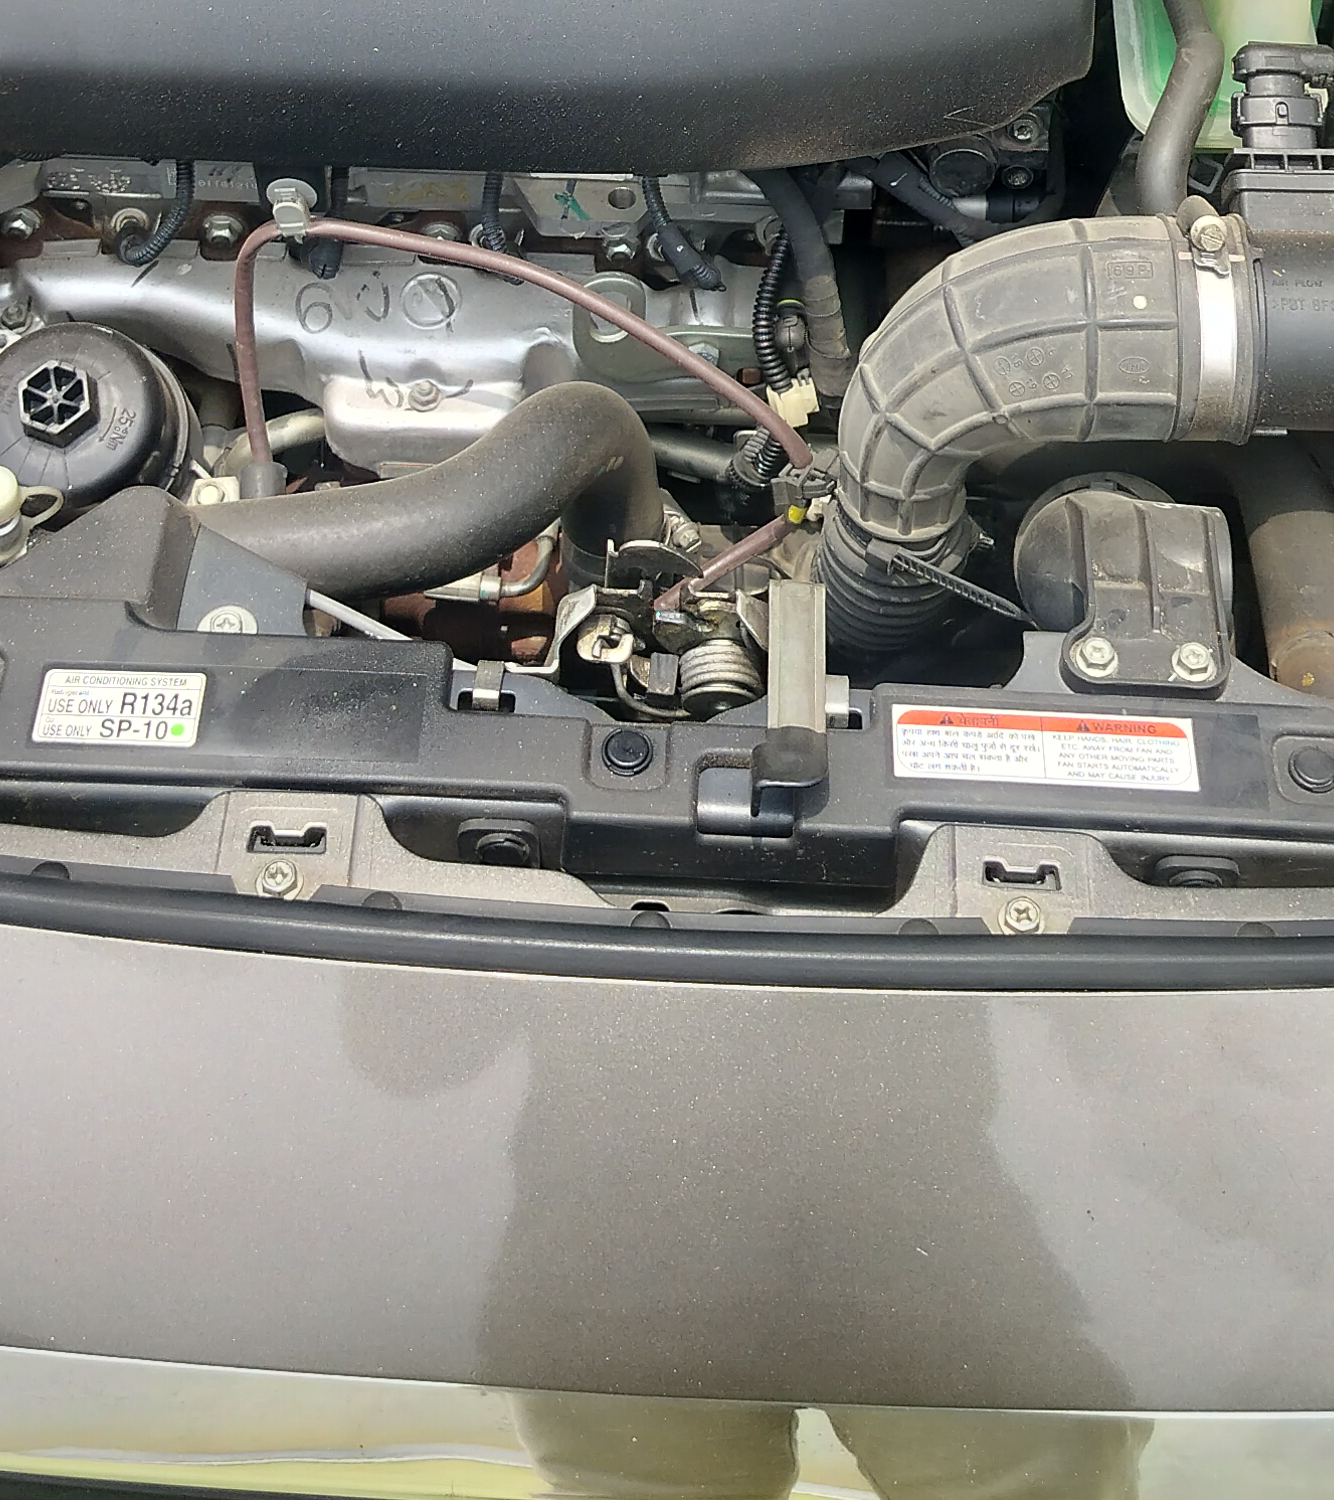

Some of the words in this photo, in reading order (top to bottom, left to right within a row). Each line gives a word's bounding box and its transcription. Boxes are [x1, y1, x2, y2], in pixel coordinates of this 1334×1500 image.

[64, 675, 81, 685] AIR
[82, 675, 149, 687] CONDITIONING
[150, 677, 188, 688] SYSTEM
[47, 698, 74, 714] USE
[78, 698, 114, 715] ONLY
[119, 691, 194, 717] R134a
[42, 723, 64, 737] USE
[65, 724, 93, 738] ONLY
[99, 717, 169, 740] SP-10
[1092, 721, 1158, 735] WARNING
[1082, 744, 1106, 752] AWAY
[1058, 752, 1076, 760] ANY
[1078, 753, 1108, 761] OTHER
[1110, 755, 1145, 763] MOVING
[1057, 760, 1074, 768] FAN
[1077, 761, 1109, 770] STARTS
[1067, 770, 1085, 778] AND
[1087, 771, 1105, 779] MAY
[1108, 772, 1137, 781] CAUSE
